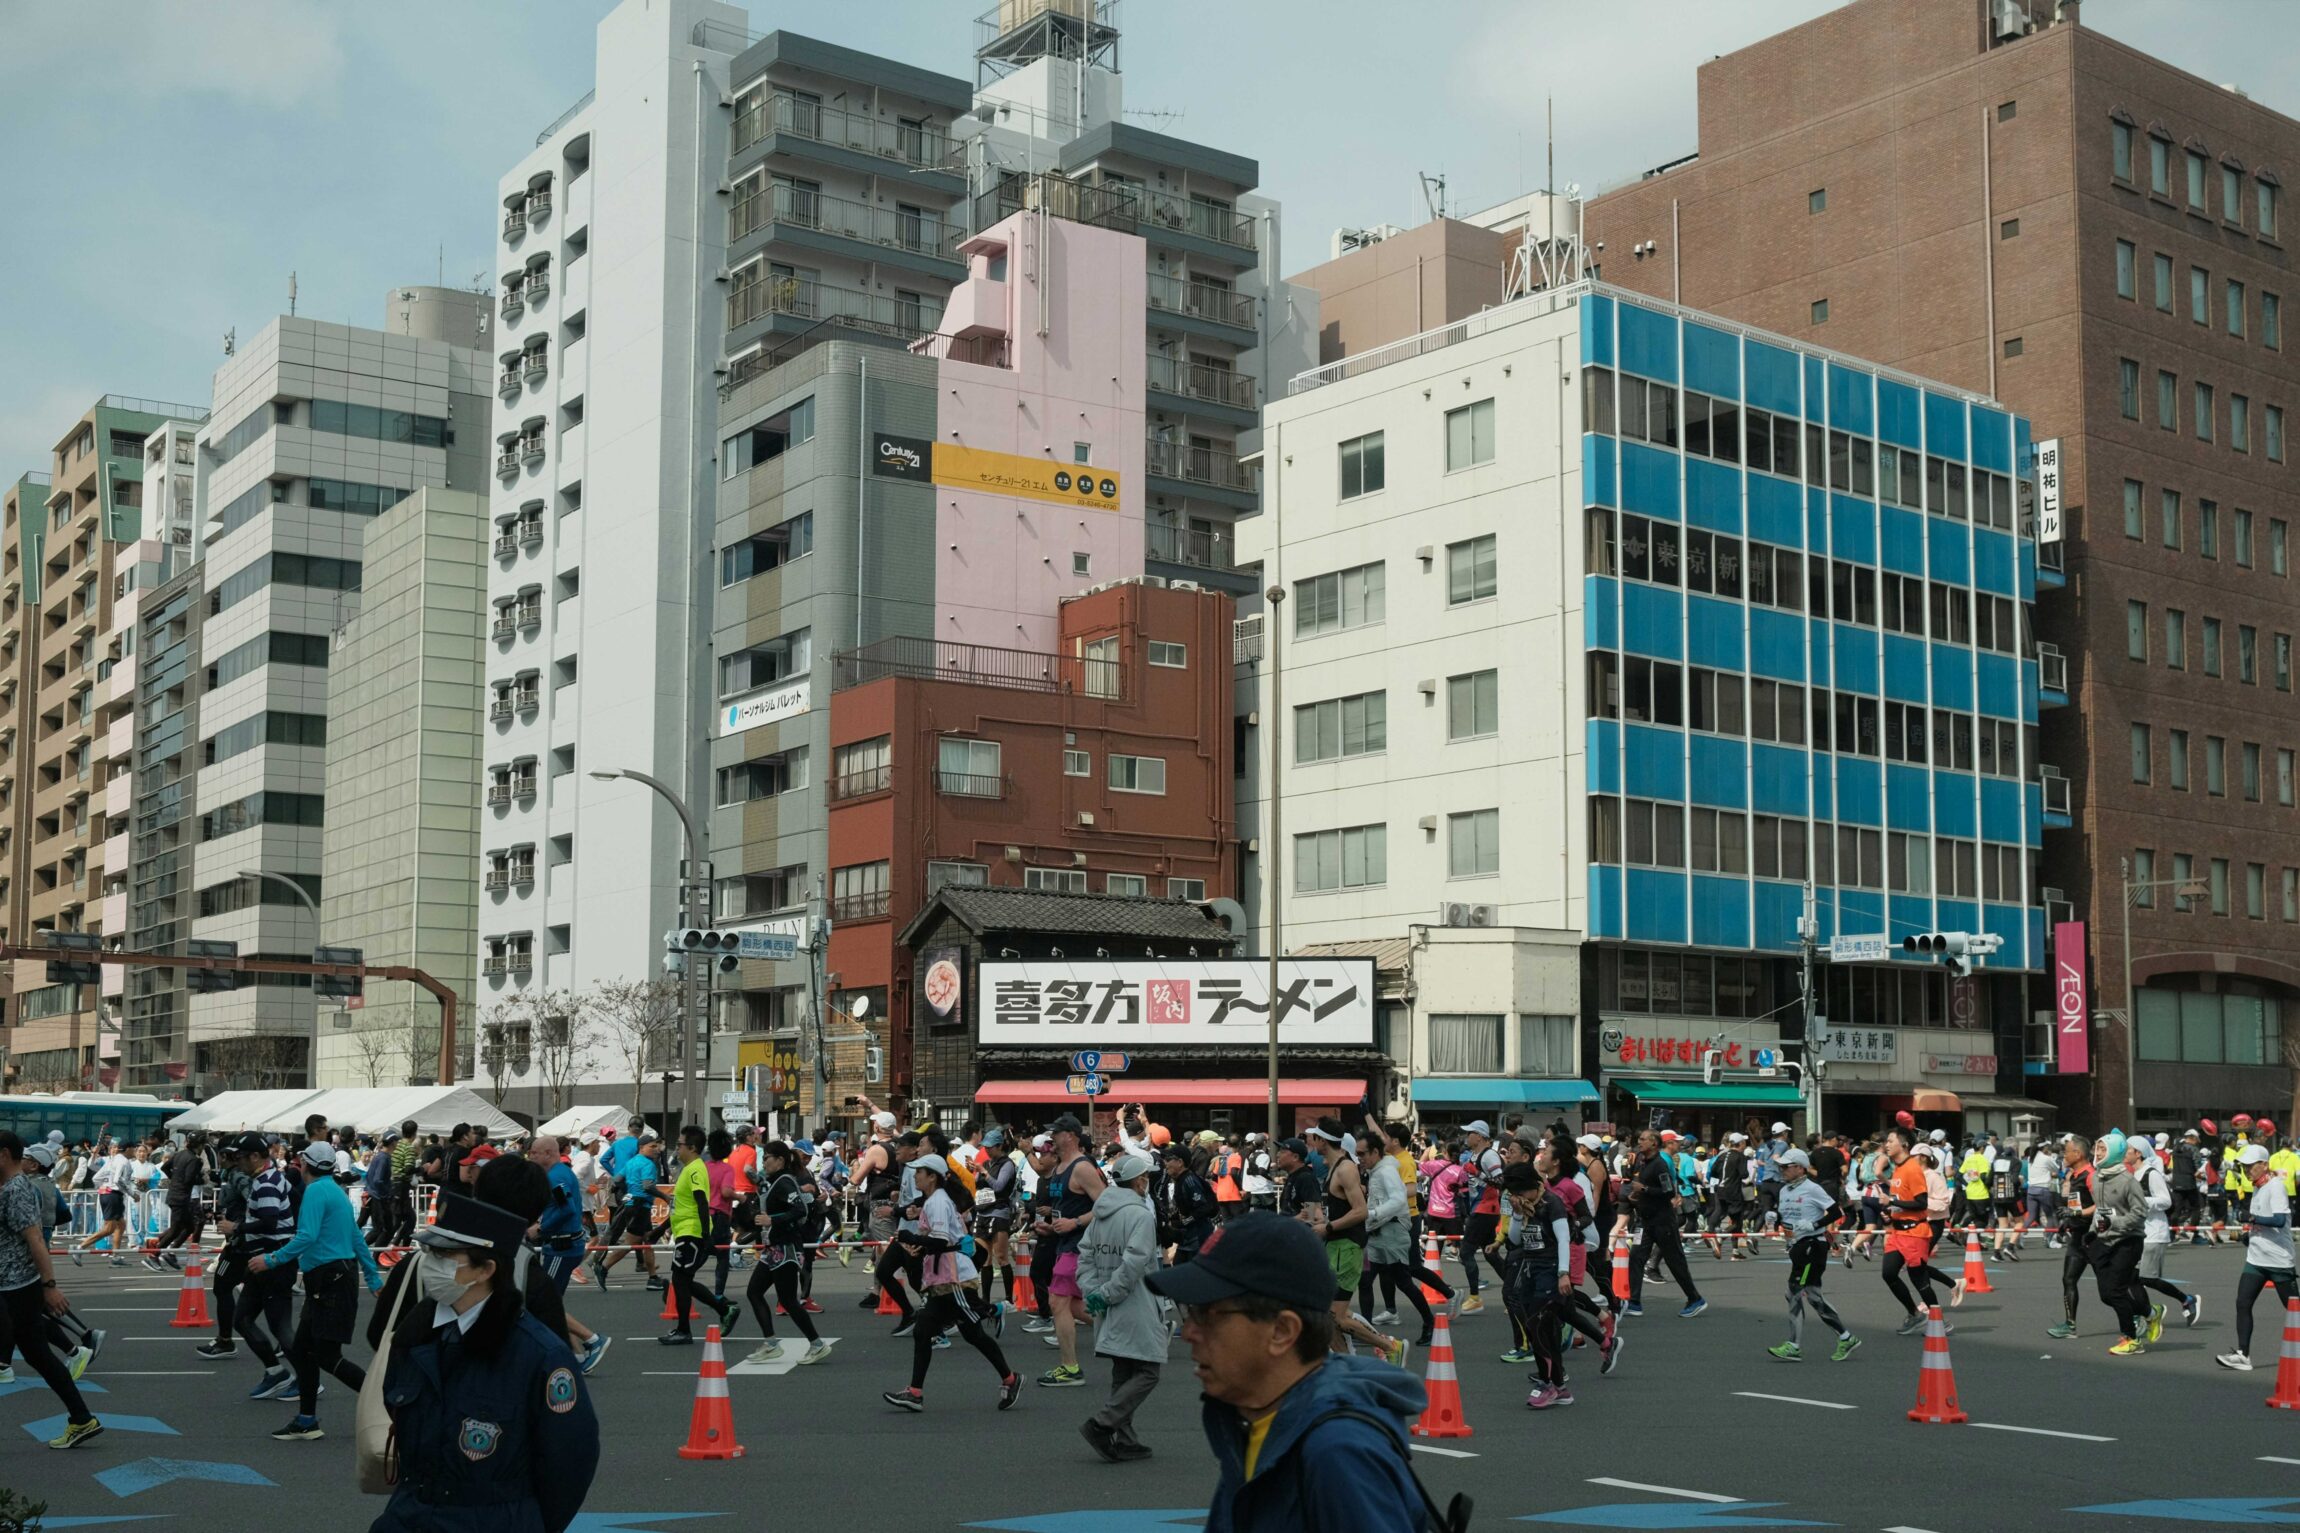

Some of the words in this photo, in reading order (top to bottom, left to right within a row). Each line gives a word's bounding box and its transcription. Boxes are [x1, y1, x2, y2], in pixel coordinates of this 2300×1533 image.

[880, 442, 914, 458] Century
[910, 455, 920, 467] 21
[2042, 449, 2058, 534] 明祐ビル
[995, 979, 1140, 1025] 喜多方
[1197, 979, 1357, 1025] ラーメン
[1620, 1036, 1742, 1067] まいばすけと
[1835, 1030, 1894, 1050] 東京新聞
[1086, 1054, 1096, 1067] 6
